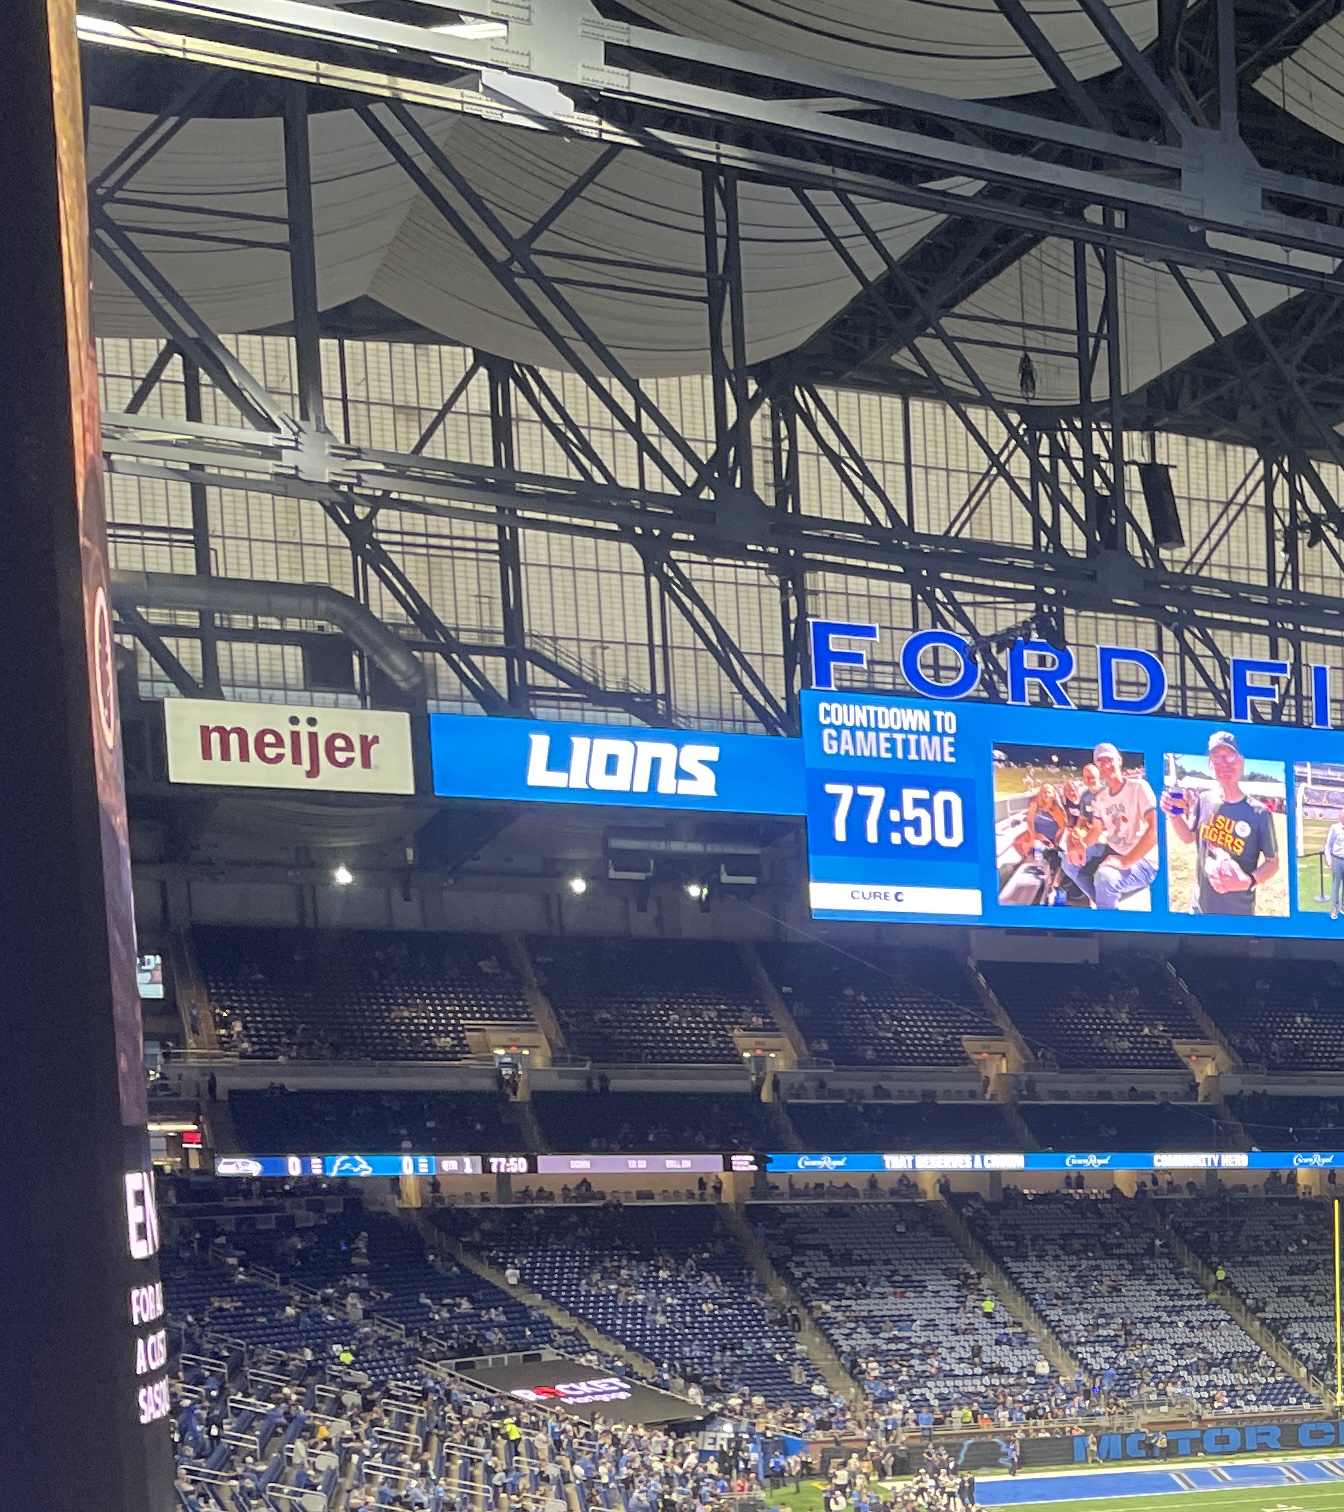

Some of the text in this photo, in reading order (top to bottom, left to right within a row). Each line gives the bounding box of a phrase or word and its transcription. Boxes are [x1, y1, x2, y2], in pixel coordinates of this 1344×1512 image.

[808, 618, 1168, 714] FORD
[819, 702, 957, 734] COUNTDOWN TO
[200, 715, 382, 778] meijer
[527, 734, 720, 796] LIONS
[822, 728, 957, 763] GAMETIME
[824, 782, 964, 849] 77:50
[850, 889, 891, 901] CURE
[463, 1157, 473, 1174] 1
[490, 1157, 527, 1173] 77:50
